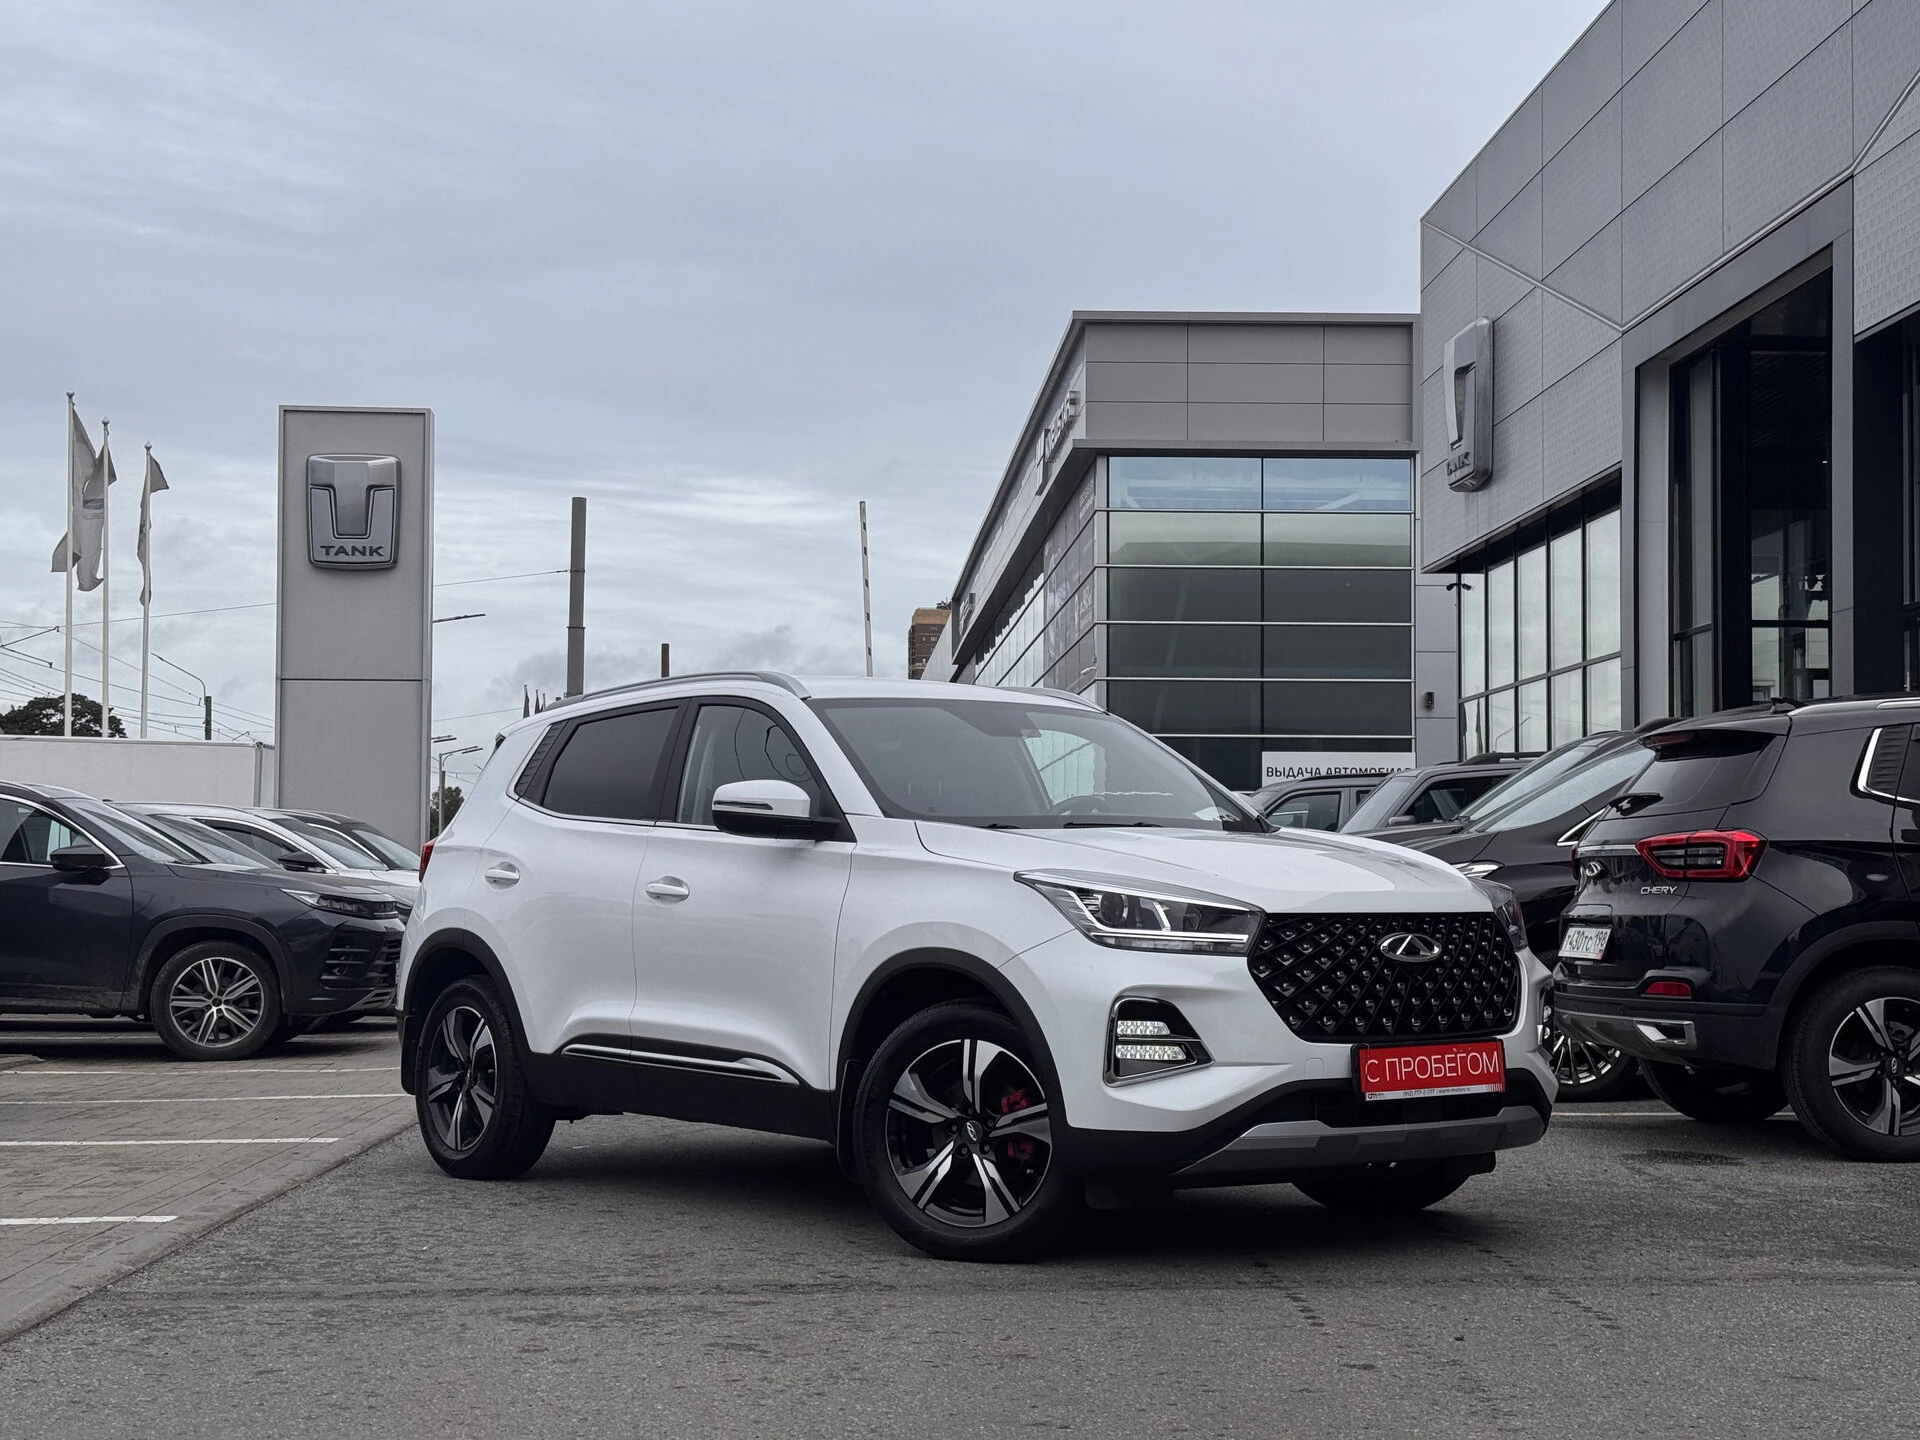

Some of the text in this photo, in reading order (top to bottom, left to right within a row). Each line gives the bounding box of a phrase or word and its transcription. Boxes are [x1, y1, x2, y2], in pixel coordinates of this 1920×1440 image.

[319, 545, 385, 557] TANK
[1266, 766, 1412, 779] ВЫДАЧА АВТОМОБИ
[1640, 886, 1678, 894] CHERY
[1365, 1051, 1500, 1083] С ПРОБЕГОМ
